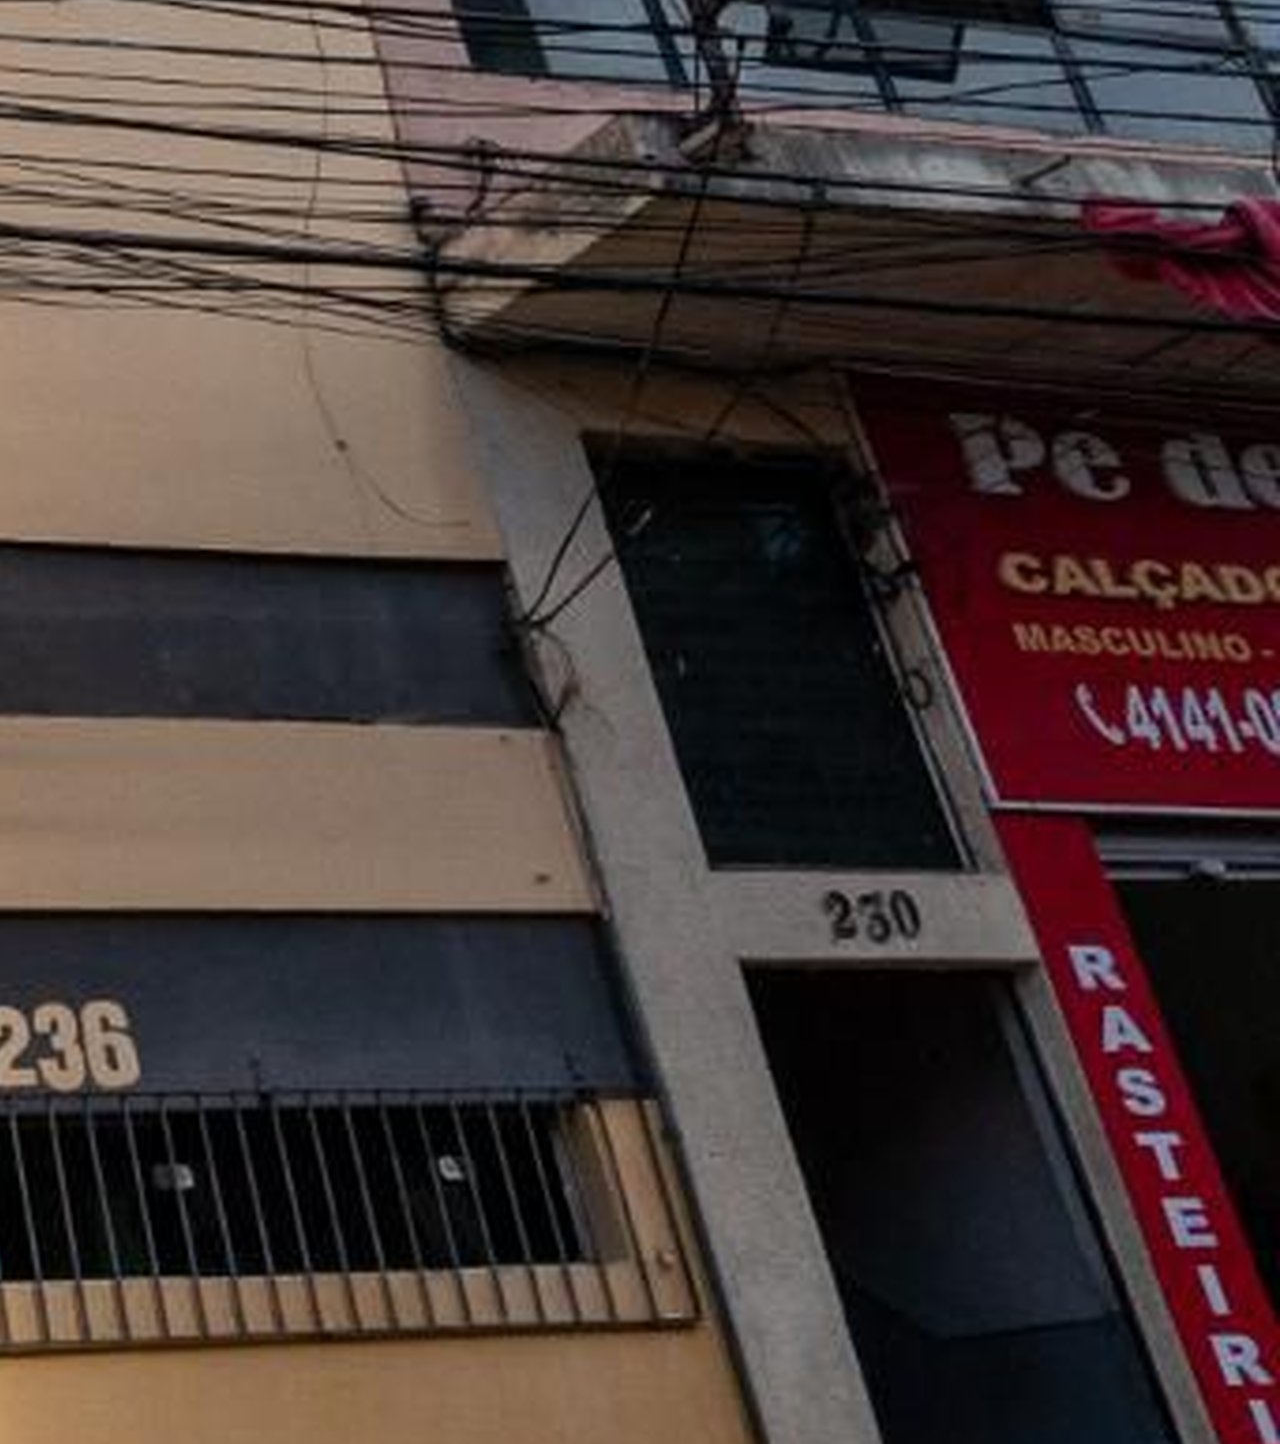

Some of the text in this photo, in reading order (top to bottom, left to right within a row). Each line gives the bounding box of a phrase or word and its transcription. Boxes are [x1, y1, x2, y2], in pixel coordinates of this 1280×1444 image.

[1012, 622, 1251, 662] MASCULINO
[1125, 684, 1280, 755] 4141-0
[822, 889, 922, 944] 230
